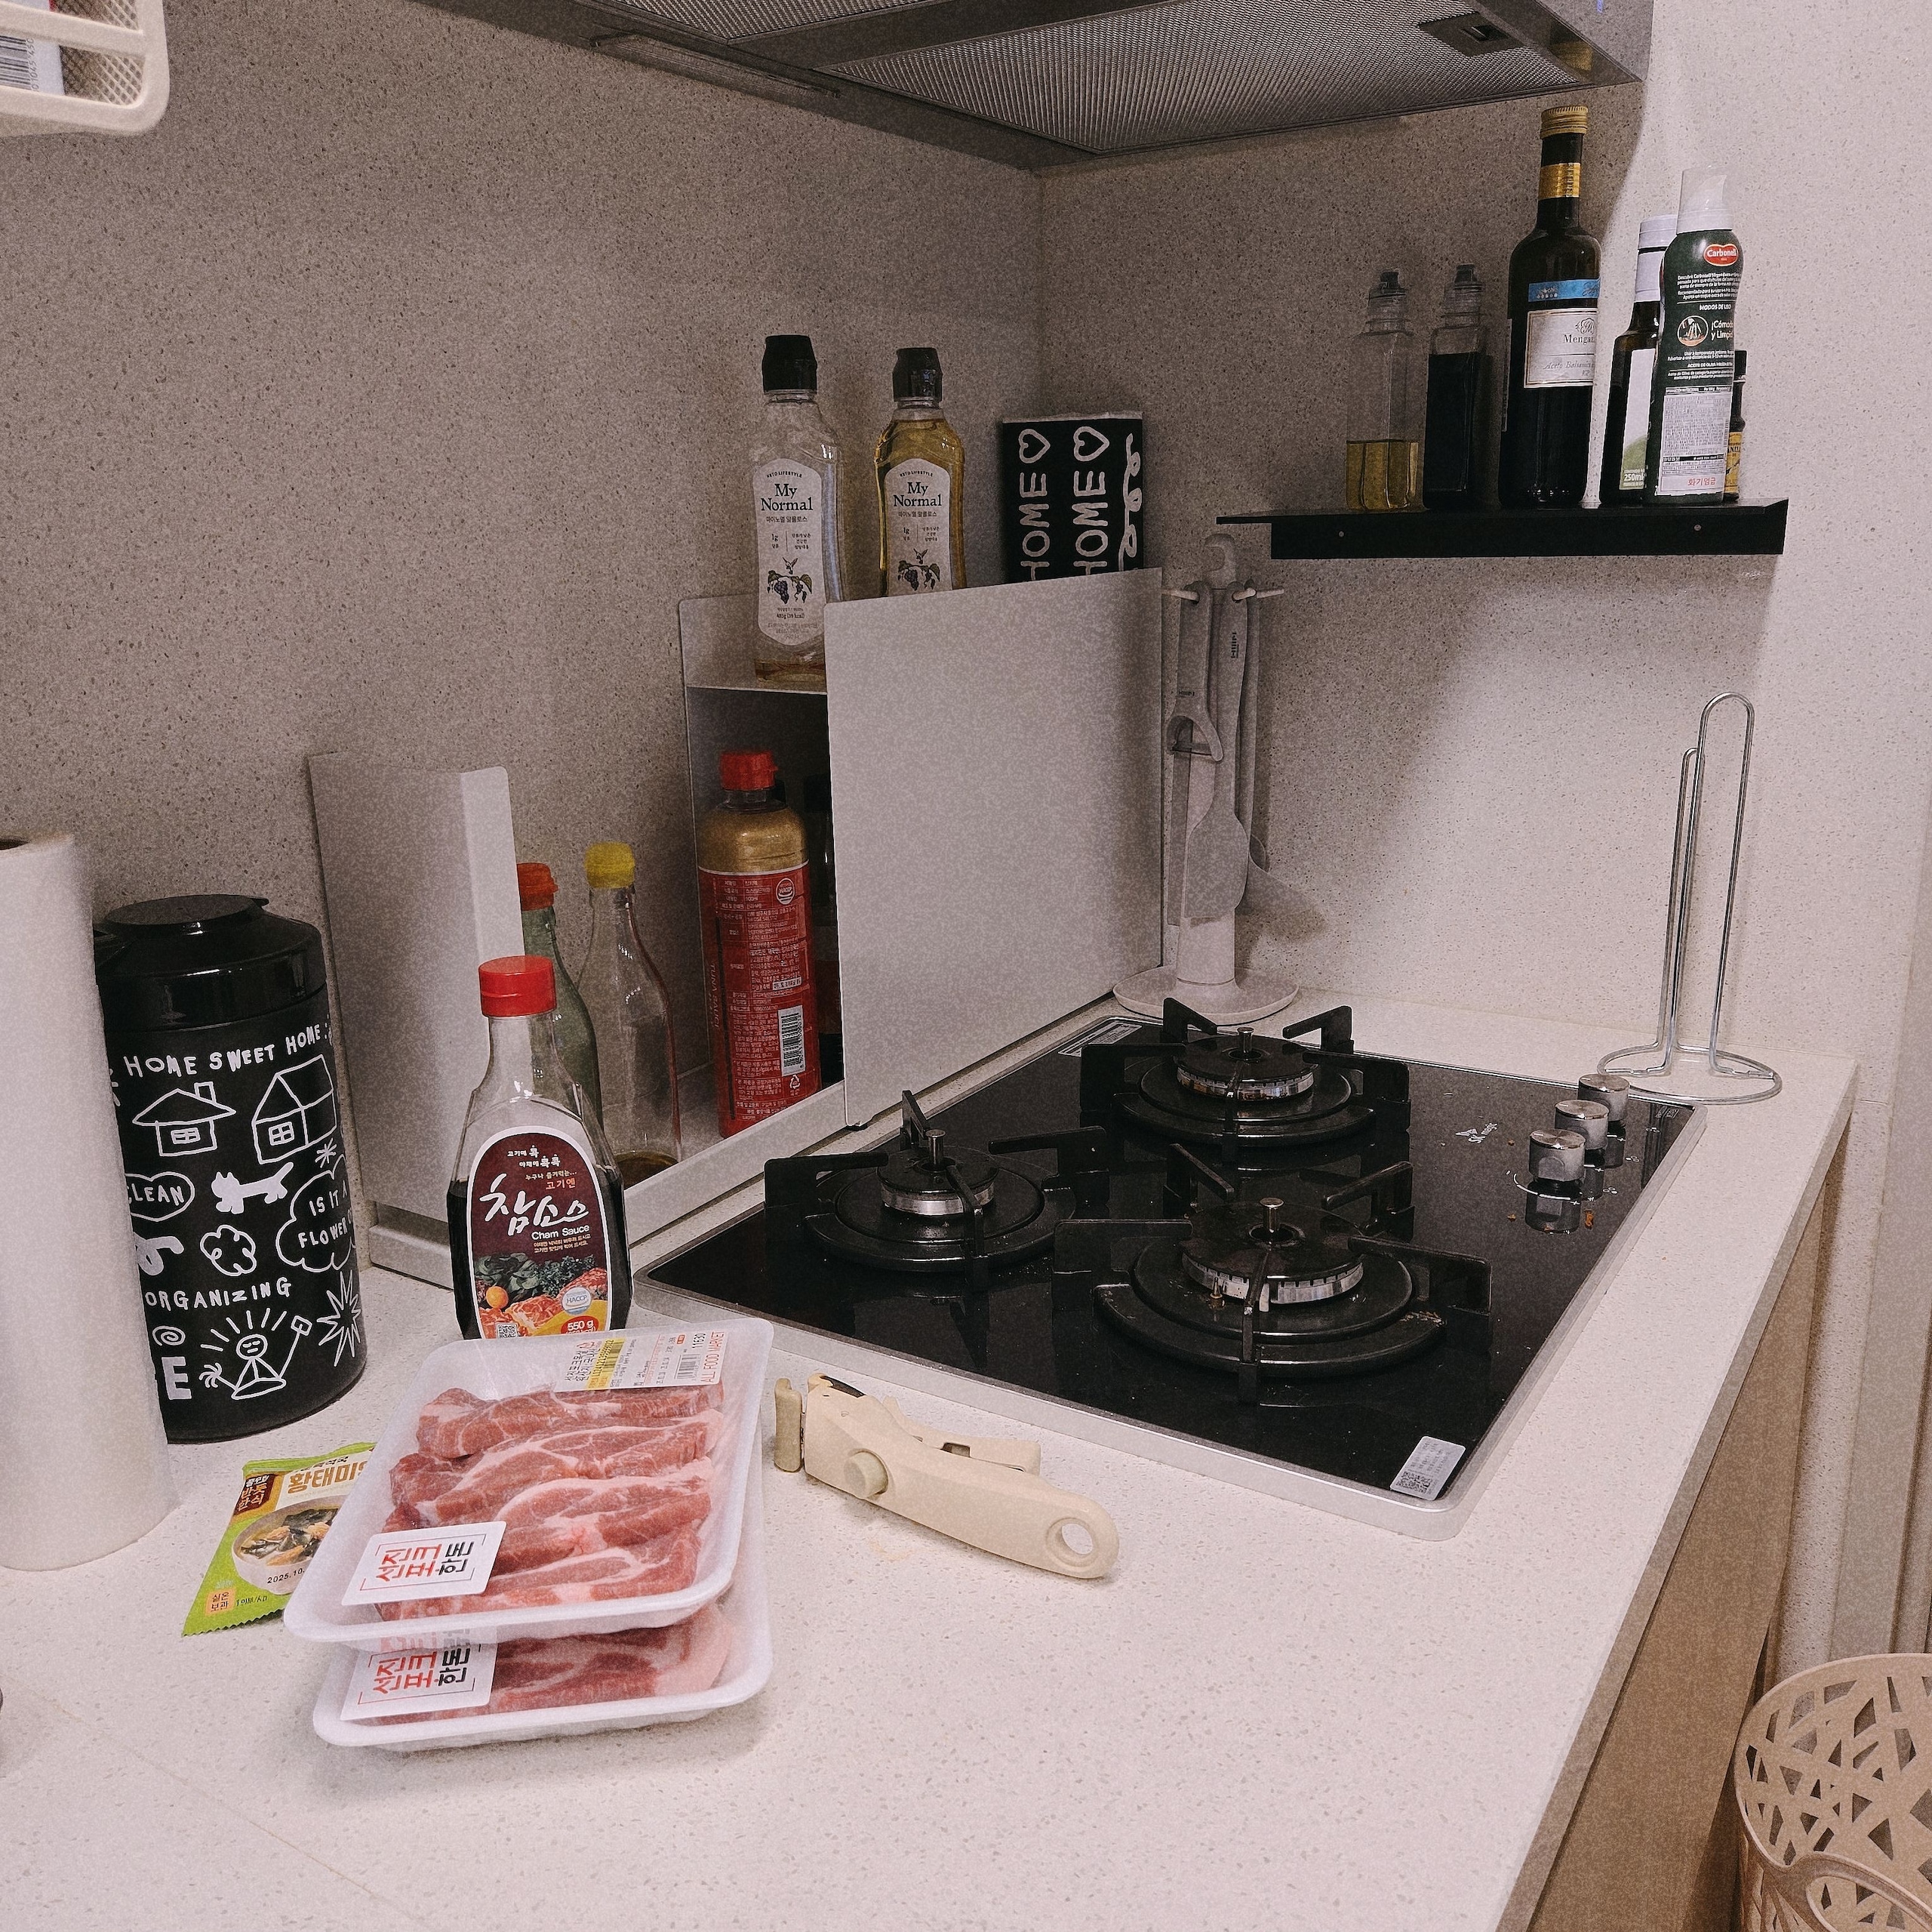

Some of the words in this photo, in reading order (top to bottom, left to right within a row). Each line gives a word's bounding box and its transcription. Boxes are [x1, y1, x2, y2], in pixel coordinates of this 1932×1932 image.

[1707, 248, 1737, 257] Carbonell
[1711, 331, 1715, 340] y
[907, 481, 928, 496] My
[1687, 477, 1716, 486] 화기엄금
[774, 483, 798, 499] My
[761, 497, 814, 511] Normal
[893, 494, 943, 507] Normal
[771, 534, 779, 542] 1g
[710, 964, 718, 992] TUNA
[124, 1055, 198, 1078] HOME
[210, 1044, 275, 1072] SWEET
[546, 1177, 576, 1189] 고기엔
[127, 1183, 185, 1206] LEAN
[309, 1196, 325, 1217] IS
[329, 1189, 339, 1209] IT
[479, 1173, 589, 1236] 참소스
[531, 1231, 559, 1240] Cham
[562, 1225, 590, 1236] Sauce
[145, 1277, 292, 1311] ORGANIZING
[567, 1295, 587, 1304] HACCP
[568, 1320, 586, 1331] 550
[587, 1319, 594, 1328] g
[691, 1333, 706, 1348] 11630
[707, 1331, 724, 1352] MARKET
[703, 1353, 719, 1369] FOOD
[700, 1371, 715, 1383] ALL
